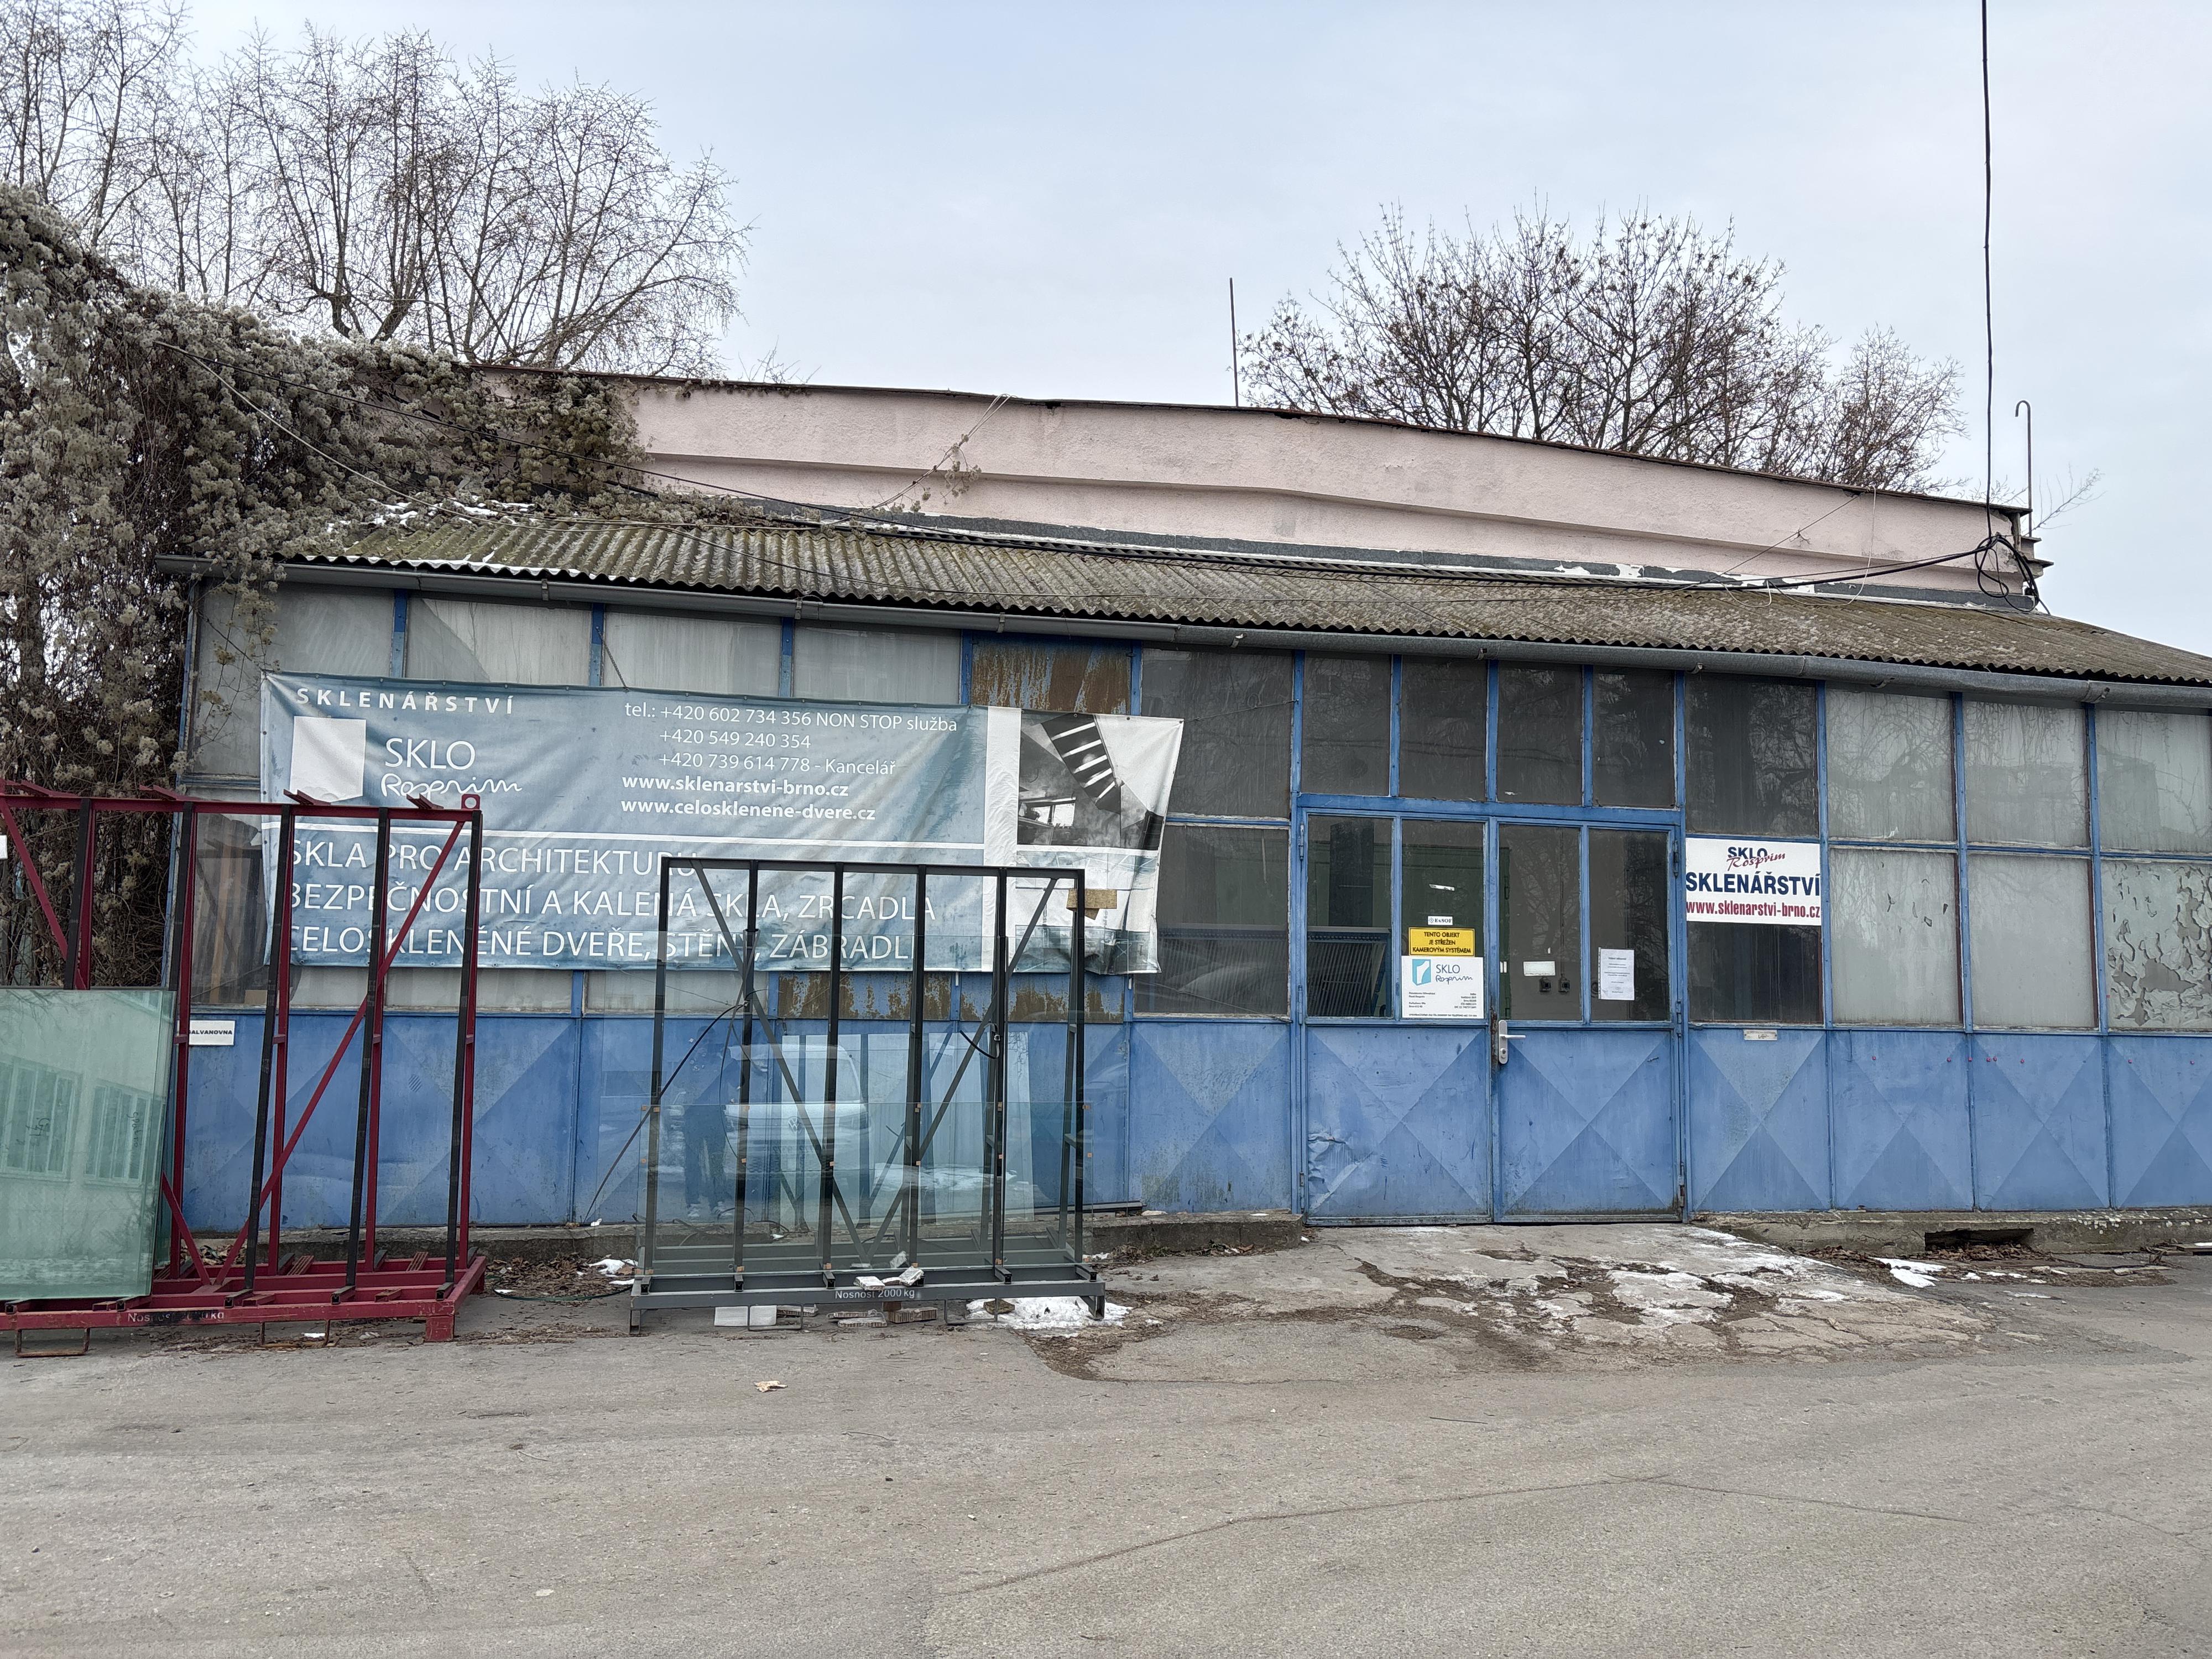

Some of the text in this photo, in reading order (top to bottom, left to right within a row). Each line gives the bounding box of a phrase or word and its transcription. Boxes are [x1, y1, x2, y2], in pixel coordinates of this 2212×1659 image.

[297, 687, 513, 714] SKLENÁŘSTVÍ
[625, 702, 957, 731] tel.: +420 602 734 356 NON STOP služba
[660, 729, 811, 749] +420 549 240 354
[385, 738, 475, 770] SKLO
[659, 753, 703, 768] +420
[708, 754, 739, 769] 739
[744, 755, 775, 770] 614
[780, 757, 810, 772] 778
[825, 759, 896, 775] Kancelář
[622, 776, 849, 797] www.sklenarstvi-brno.cz
[620, 799, 875, 821] www.celosklenene-dvere.cz
[1726, 853, 1786, 871] Rosprim
[1728, 847, 1768, 859] SKLO
[1686, 871, 1820, 896] SKLENÁŘSTVÍ
[541, 890, 562, 915] A
[1686, 900, 1820, 918] www.sklenarstvi-brno.cz
[542, 927, 650, 961] DVEŘE,
[1436, 964, 1460, 973] SKLO
[835, 1288, 915, 1298] Nosnost 2000 kg
